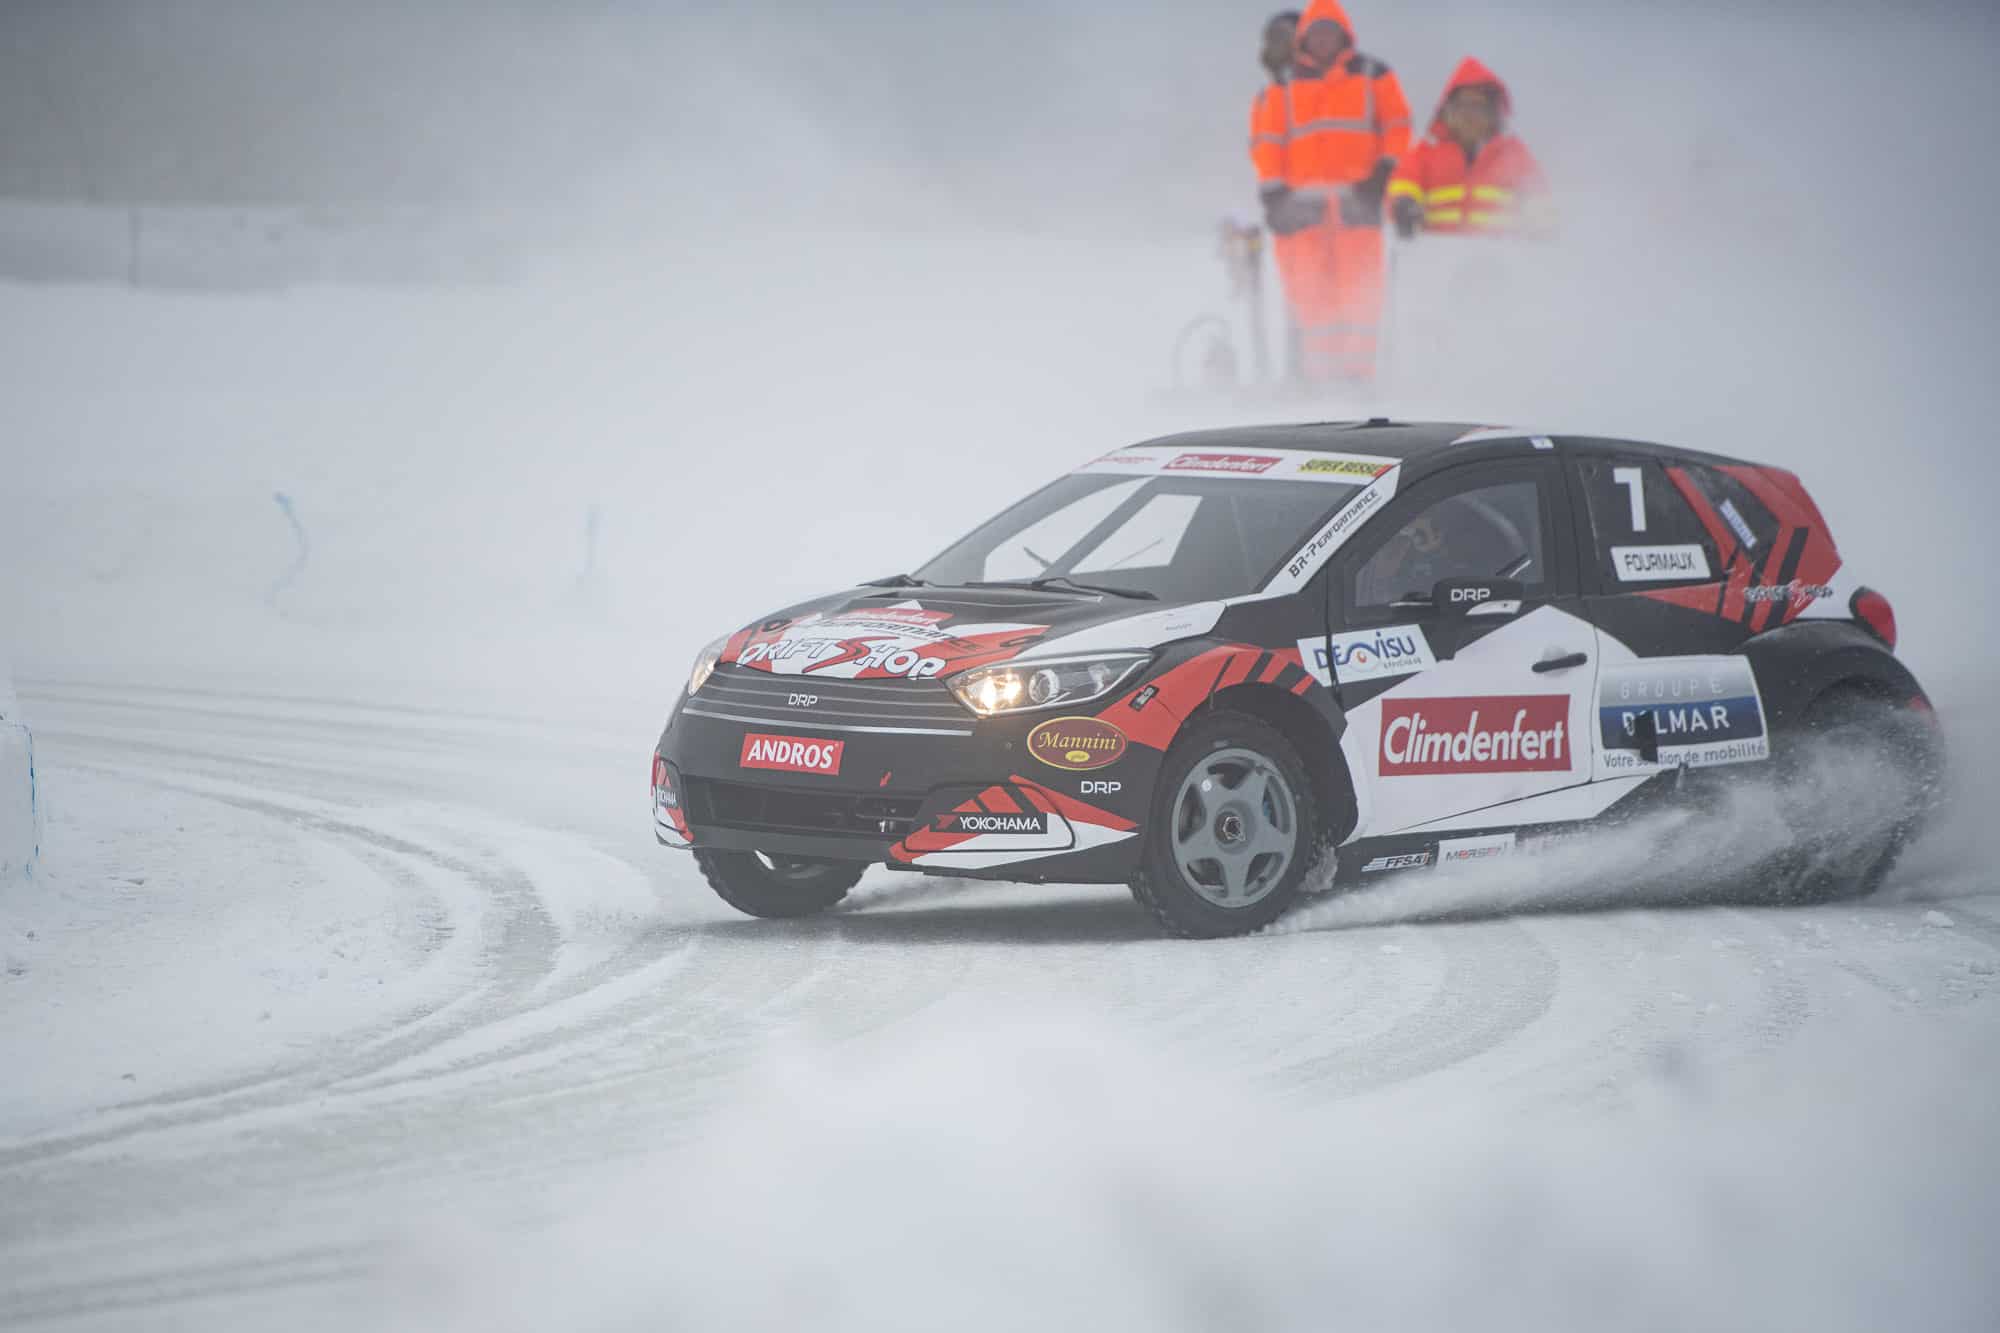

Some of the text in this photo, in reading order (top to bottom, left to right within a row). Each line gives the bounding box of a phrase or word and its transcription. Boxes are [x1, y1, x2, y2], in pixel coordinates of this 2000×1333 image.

[1613, 467, 1646, 531] 1
[1624, 552, 1696, 572] FOURMAUX
[1451, 588, 1490, 601] DRP
[735, 638, 840, 668] DRIFT
[1620, 678, 1725, 699] GROUPE
[788, 693, 818, 707] DRP
[1622, 702, 1731, 735] DLMAR
[1037, 732, 1118, 750] Mannini
[1384, 709, 1563, 764] Climdenfert
[747, 738, 834, 769] ANDROS
[1604, 754, 1633, 768] Votre
[1684, 751, 1699, 764] de
[1704, 742, 1766, 761] mobilité
[1080, 781, 1121, 794] DRP
[959, 816, 1041, 831] YOKOHAMA
